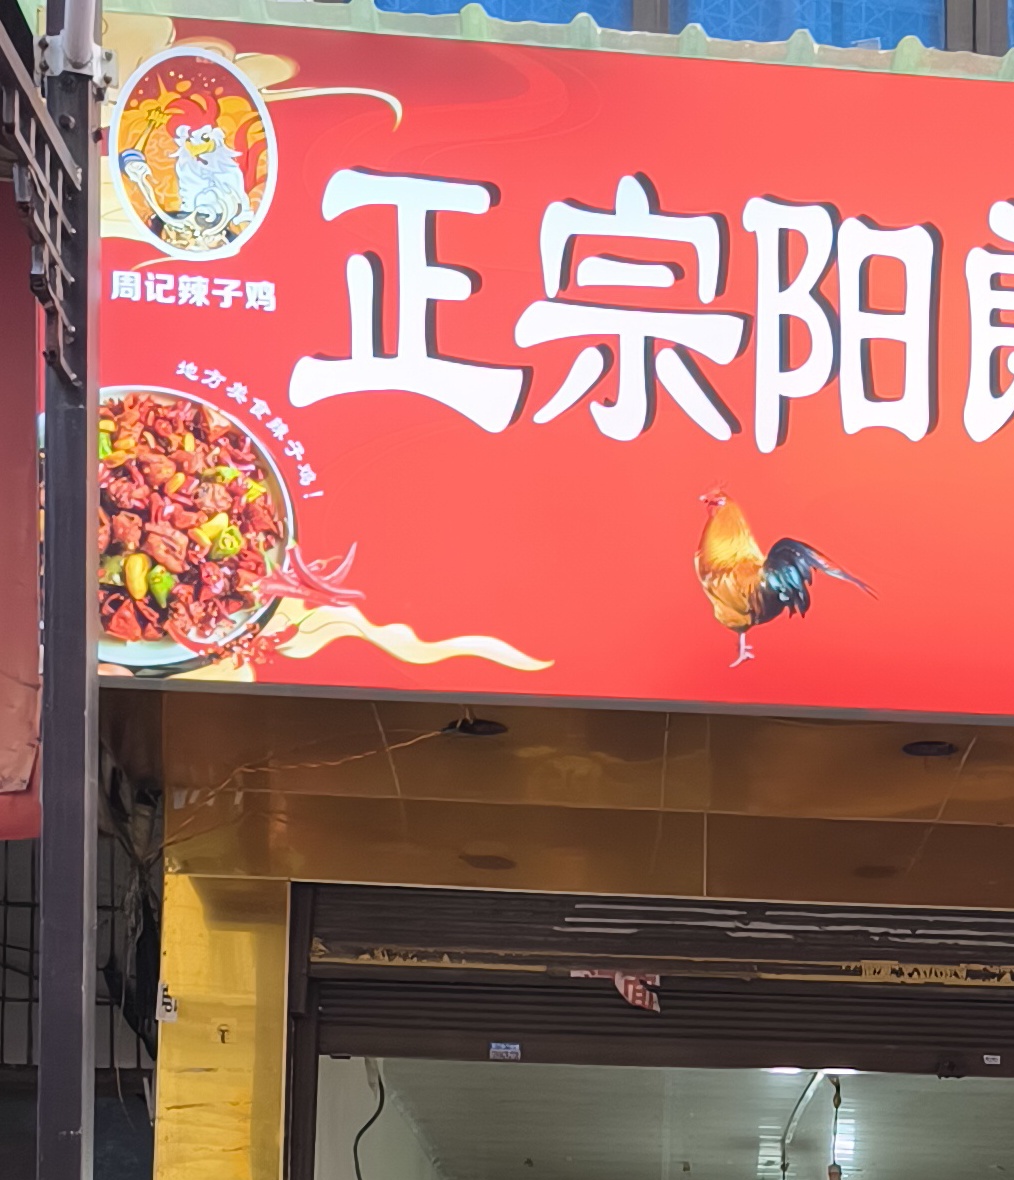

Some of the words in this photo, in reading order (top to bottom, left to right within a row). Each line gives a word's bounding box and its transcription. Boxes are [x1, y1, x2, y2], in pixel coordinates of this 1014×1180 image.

[110, 269, 277, 312] 周记辣子鸡
